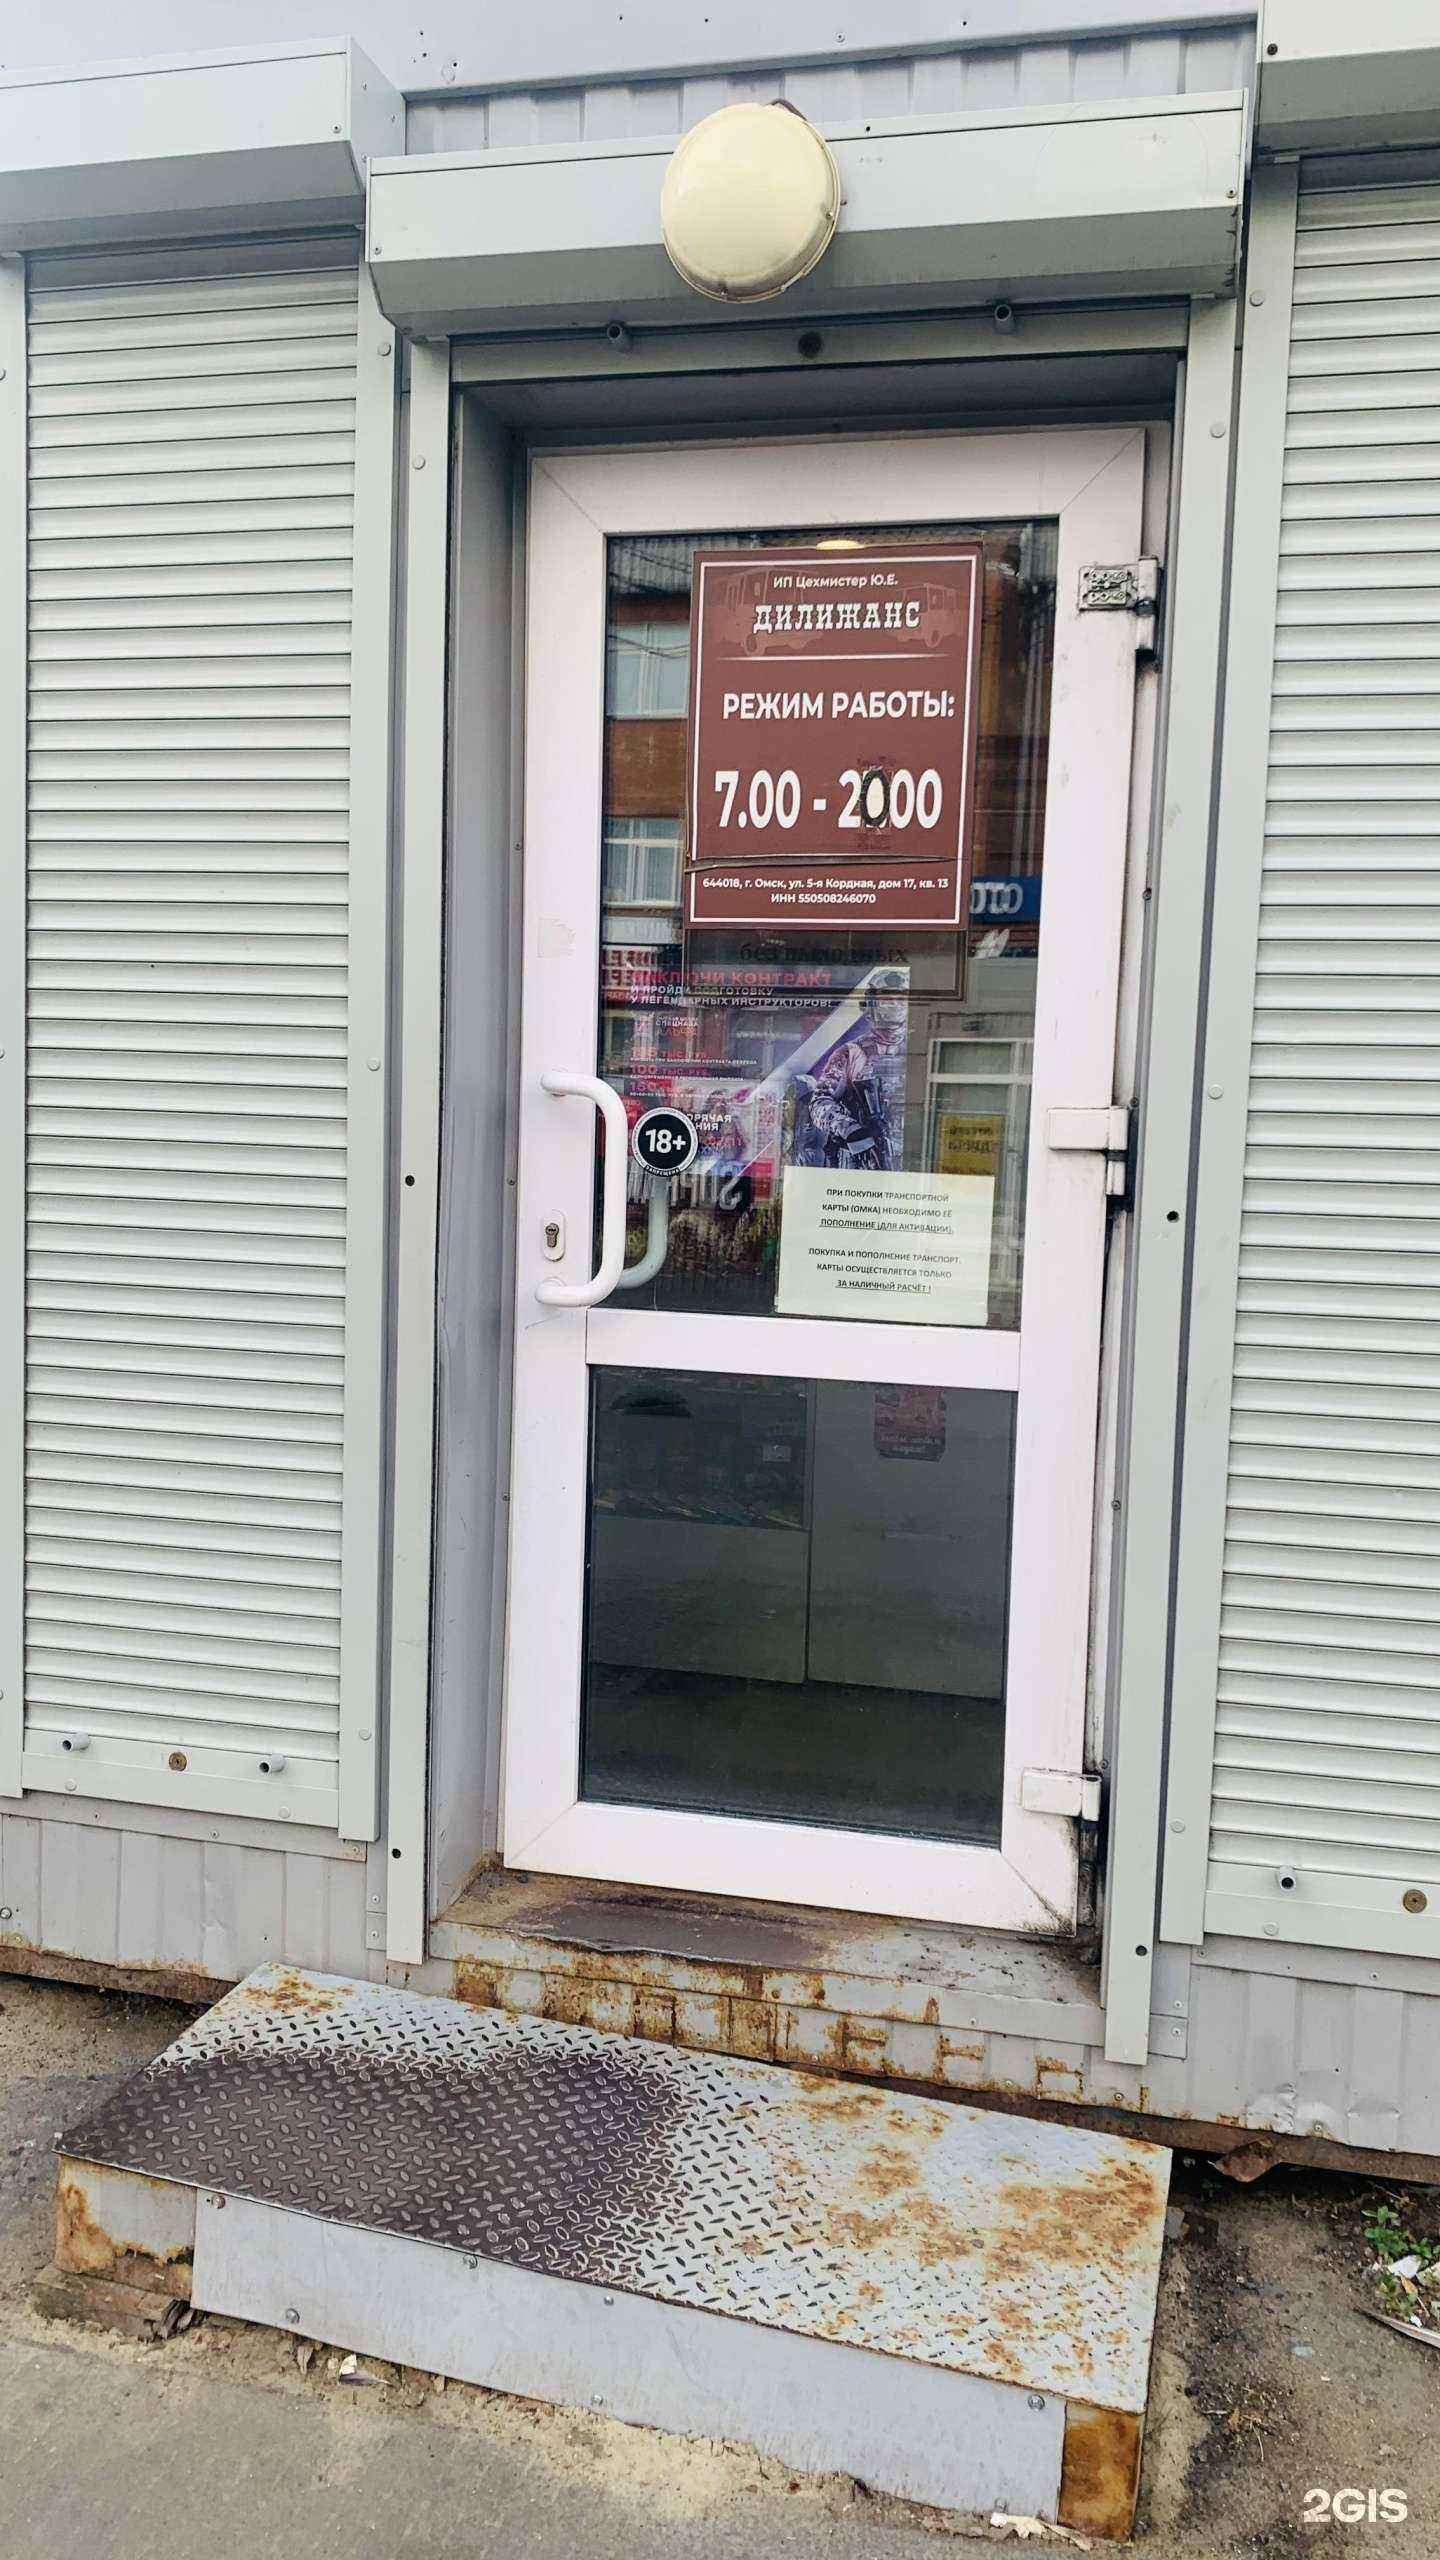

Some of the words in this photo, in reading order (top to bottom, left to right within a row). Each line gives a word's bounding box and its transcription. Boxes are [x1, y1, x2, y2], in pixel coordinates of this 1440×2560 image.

[774, 577, 792, 588] ИП
[796, 574, 866, 589] Цехмистер
[871, 574, 898, 586] Ю.Е.
[753, 601, 921, 633] ДИЛИЖАНС
[723, 692, 823, 720] РЕЖИМ
[832, 690, 954, 719] РАБОТЫ:
[715, 770, 801, 828] 7.00
[703, 879, 742, 890] 644018,
[746, 880, 752, 888] г.
[755, 878, 785, 890] Омск,
[789, 879, 804, 890] ул.
[807, 878, 823, 888] 5-я
[826, 878, 876, 890] Кордная,
[878, 879, 900, 890] дом
[904, 878, 916, 890] 17,
[920, 880, 935, 888] кв.
[939, 878, 948, 888] 13
[771, 894, 796, 904] ИНН
[798, 894, 876, 904] 550508246070
[732, 972, 832, 986] КОНТРАКТ
[630, 986, 638, 994] И
[630, 996, 639, 1005] У
[640, 996, 729, 1007] ЛЕГЕНДАРНЫХ
[732, 997, 832, 1008] ИНСТРУКТОРОВ!
[631, 1064, 656, 1074] 100
[646, 1128, 686, 1153] 18+
[827, 1188, 842, 1197] ПРИ
[845, 1189, 883, 1199] ПОКУПКИ
[885, 1191, 949, 1202] ТРАНСПОРТНОЙ
[822, 1204, 849, 1212] КАРТЫ
[850, 1204, 880, 1214] (ОМКА)
[882, 1206, 941, 1218] НЕОБХОДИМО
[821, 1218, 876, 1229] ПОПОЛНЕНИЕ
[878, 1221, 897, 1230] (ДЛЯ
[808, 1248, 846, 1258] ПОКУПКА
[848, 1250, 854, 1258] И
[856, 1250, 910, 1262] ПОПОЛНЕНИЕ
[912, 1254, 961, 1264] ТРАНСПОРТ.
[817, 1264, 844, 1272] КАРТЫ
[845, 1265, 917, 1277] ОСУЩЕСТВЛЯЕТСЯ
[919, 1269, 952, 1278] ТОЛЬКО
[838, 1280, 847, 1288] ЗА
[849, 1280, 895, 1290] НАЛИЧНЫЙ
